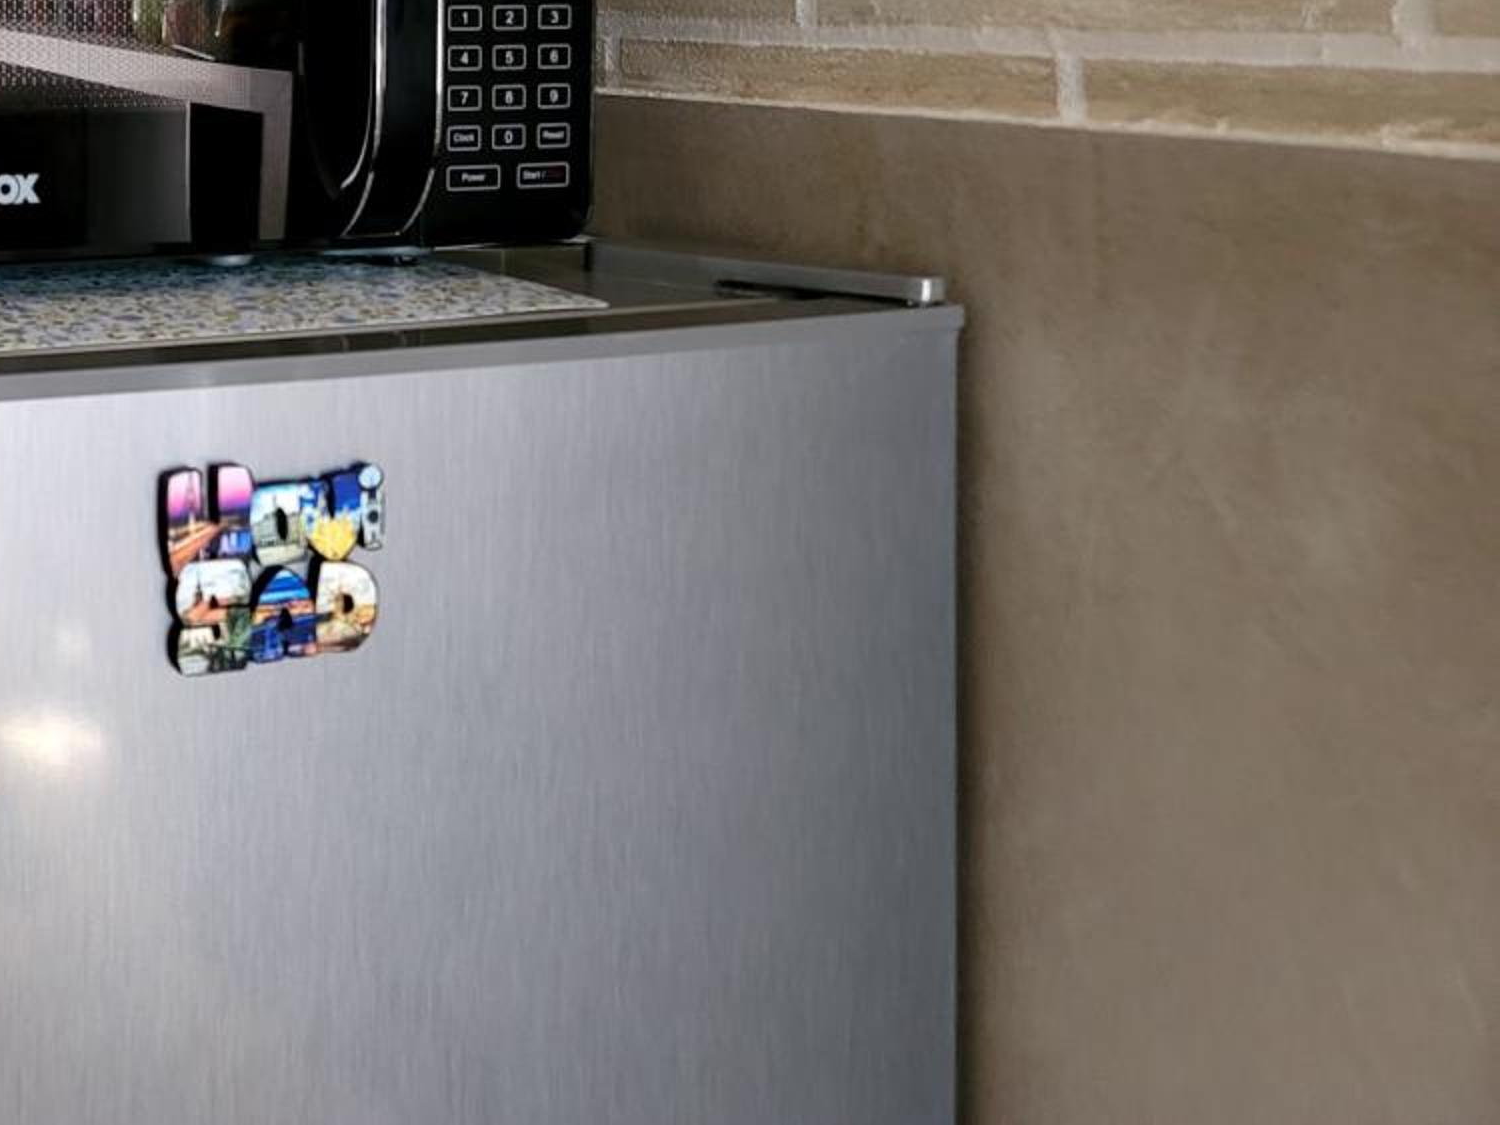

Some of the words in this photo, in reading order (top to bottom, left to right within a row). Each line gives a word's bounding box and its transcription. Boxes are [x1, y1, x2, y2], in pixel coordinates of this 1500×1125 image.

[462, 10, 469, 26] 1
[504, 10, 514, 25] 2
[550, 10, 559, 24] 3
[460, 50, 469, 65] 4
[504, 50, 514, 65] 5
[549, 48, 559, 63] 6
[461, 90, 469, 105] 7
[504, 90, 514, 104] 8
[549, 88, 559, 103] 9
[504, 129, 514, 144] 0
